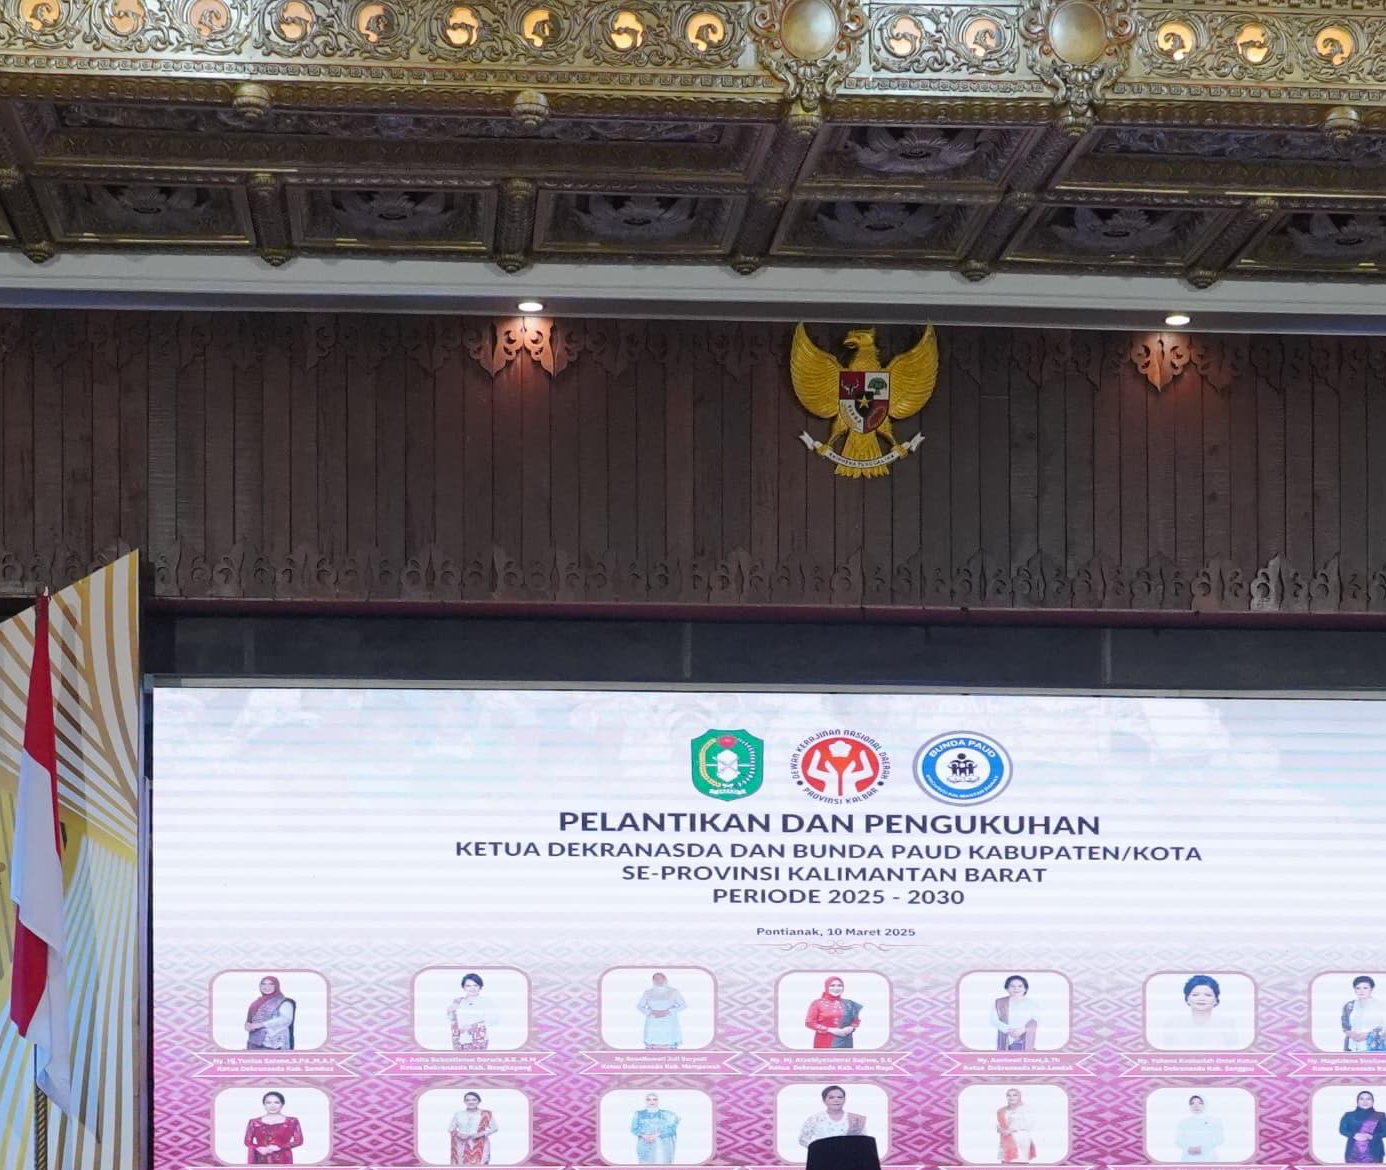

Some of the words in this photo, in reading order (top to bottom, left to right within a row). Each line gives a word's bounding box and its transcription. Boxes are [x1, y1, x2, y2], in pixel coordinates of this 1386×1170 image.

[928, 739, 966, 758] BUNDA
[968, 740, 997, 758] PAUD
[559, 811, 771, 833] PELANTIKAN
[781, 812, 855, 834] DAN
[864, 813, 1100, 835] PENGUKUHAN
[455, 841, 541, 857] KETUA
[548, 842, 723, 858] DEKRANASDA
[730, 843, 785, 858] DAN
[793, 843, 884, 859] BUNDA
[892, 844, 961, 860] PAUD
[969, 845, 1202, 862] KABUPATEN/KOTA
[622, 865, 780, 881] SE-PROVINSI
[788, 866, 957, 882] KALIMANTAN
[965, 867, 1047, 883] BARAT
[713, 888, 821, 904] PERIODE
[828, 889, 884, 904] 2025
[908, 889, 965, 905] 2030
[756, 926, 823, 938] Pontianak,
[828, 927, 843, 937] 10
[845, 927, 880, 937] Maret
[884, 927, 916, 937] 2025
